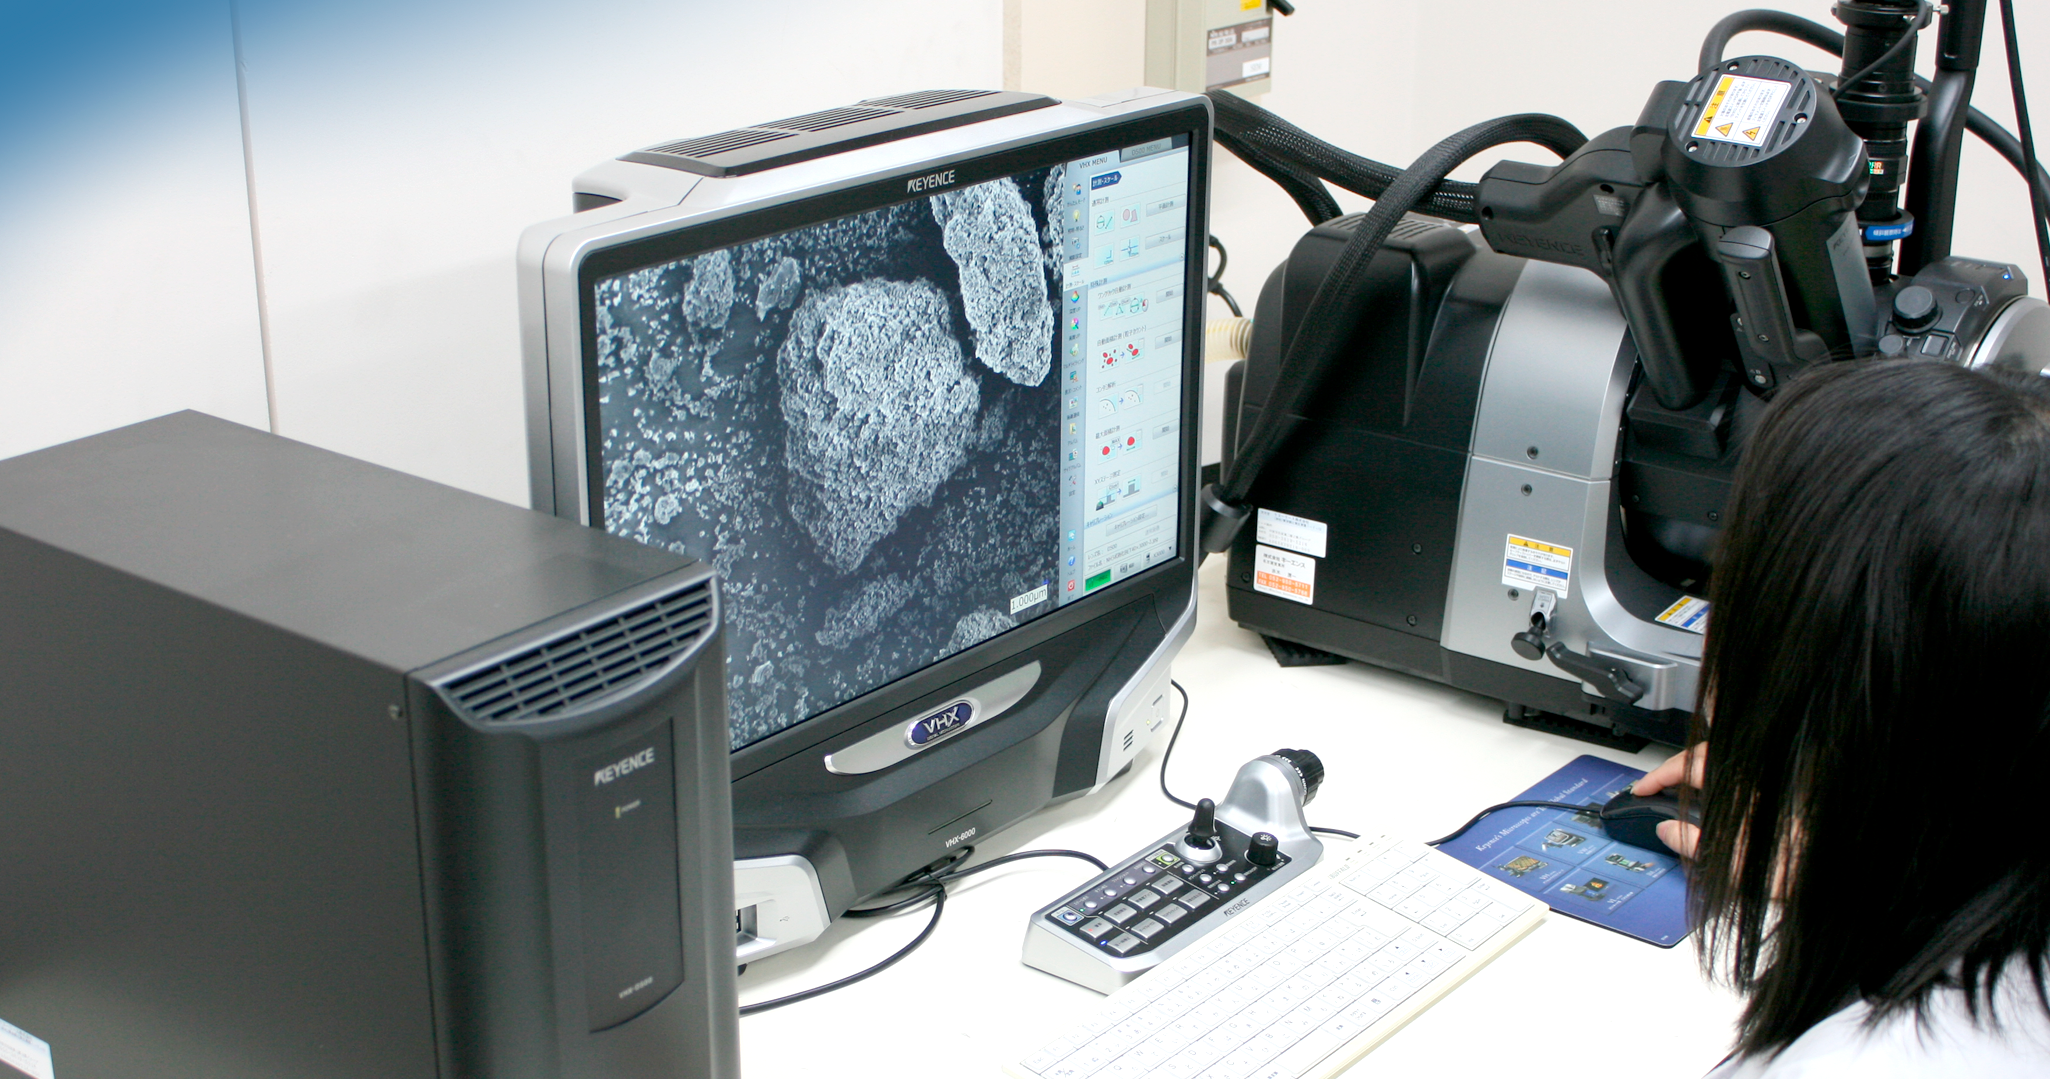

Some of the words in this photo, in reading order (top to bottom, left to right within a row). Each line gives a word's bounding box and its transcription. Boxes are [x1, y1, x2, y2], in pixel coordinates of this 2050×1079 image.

[1146, 143, 1161, 152] MENU
[1079, 161, 1091, 169] VHX
[1092, 156, 1108, 166] MENU
[907, 170, 955, 194] KEYENCE
[1281, 557, 1306, 569] キーエンス
[923, 706, 960, 733] VHX
[594, 747, 655, 787] KEYENCE
[1223, 898, 1251, 917] KEYENCE
